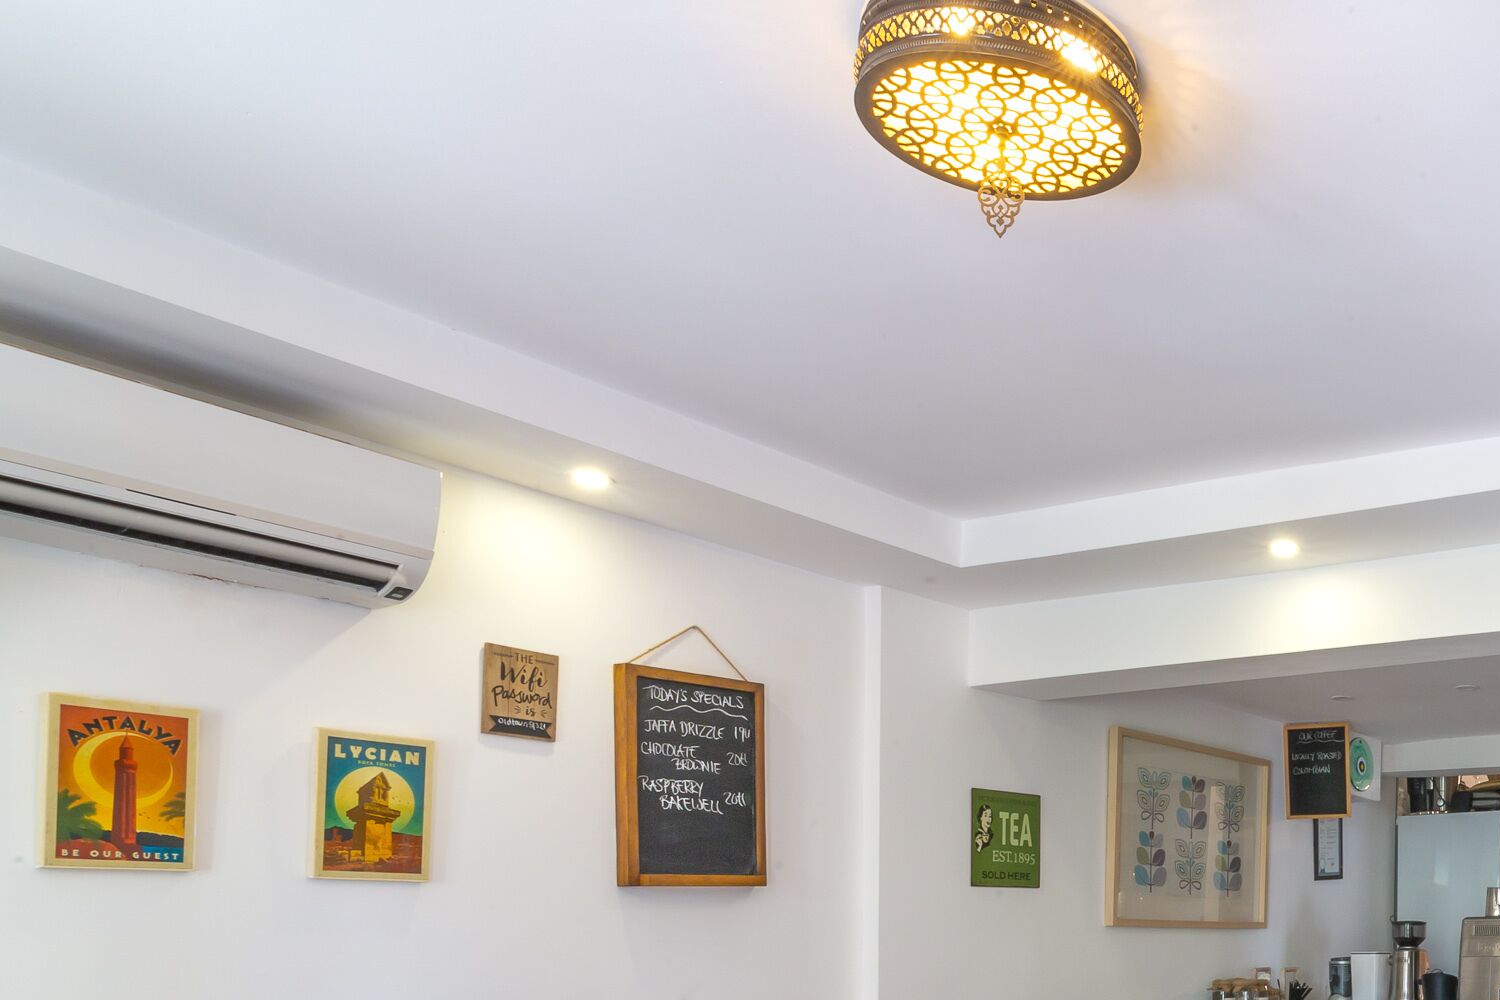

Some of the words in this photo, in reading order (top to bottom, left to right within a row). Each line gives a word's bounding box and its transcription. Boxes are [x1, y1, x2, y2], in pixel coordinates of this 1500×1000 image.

[515, 653, 534, 664] THE
[501, 661, 548, 692] Wifi
[491, 685, 552, 709] Password
[642, 685, 688, 704] TODAY'S
[691, 690, 744, 709] SPECIALS
[525, 706, 535, 716] is
[66, 716, 182, 756] ANTALYA
[644, 720, 677, 733] JAFFA
[680, 721, 725, 740] DRIZZLE
[334, 743, 420, 766] LYCIAN
[641, 741, 700, 758] CHOCOLATE
[671, 757, 722, 775] BROWNIE
[638, 775, 704, 797] RASPBERRY
[659, 794, 724, 815] BAKEWELL
[999, 811, 1032, 847] TEA
[61, 848, 80, 857] BE
[90, 849, 123, 859] OUR
[132, 851, 180, 860] GUEST
[982, 870, 1006, 879] SOLD
[1007, 872, 1031, 880] HERE
